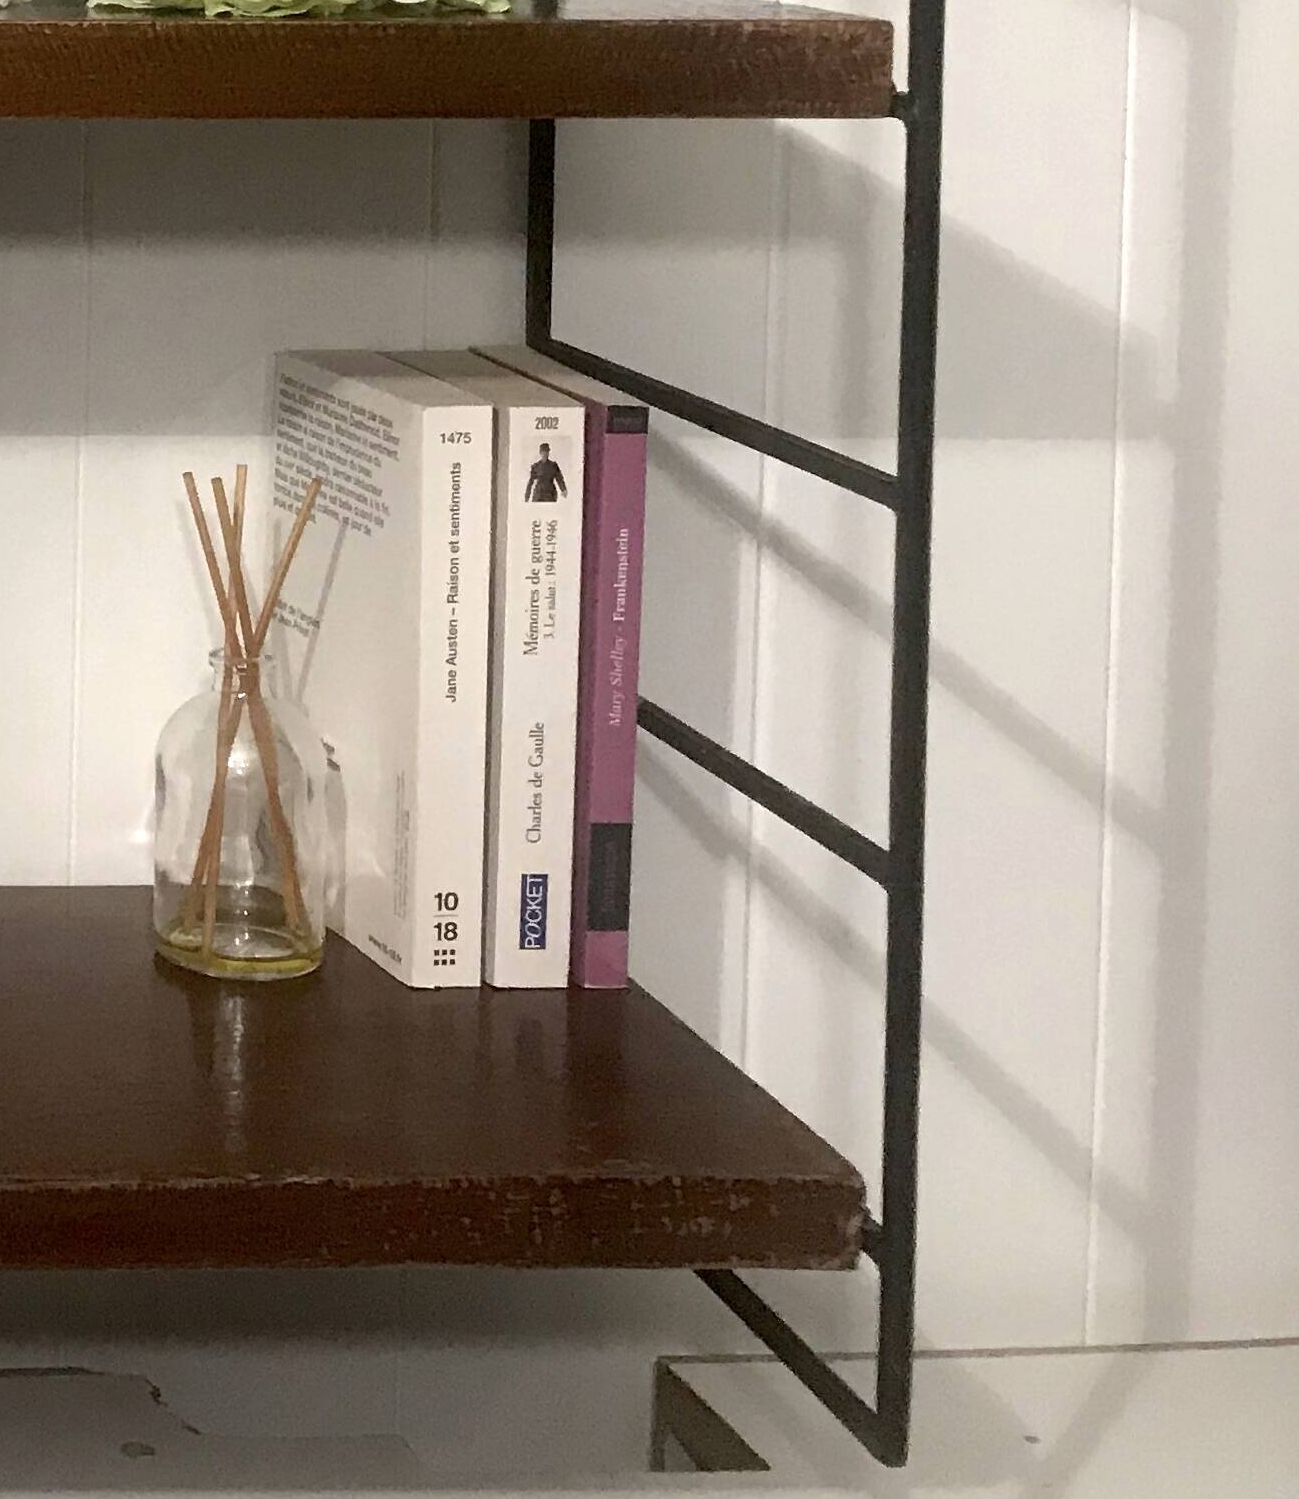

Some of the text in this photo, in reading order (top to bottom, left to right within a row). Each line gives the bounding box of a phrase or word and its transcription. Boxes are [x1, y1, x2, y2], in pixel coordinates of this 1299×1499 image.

[440, 432, 472, 444] 1475
[535, 416, 559, 430] 2002
[448, 462, 462, 537] sentiments
[450, 540, 461, 553] et
[446, 558, 461, 604] Raison
[523, 520, 543, 655] Mémoires de guerre
[613, 528, 629, 621] Frankenstein
[446, 620, 459, 666] Austen
[609, 635, 628, 686] Shelley
[445, 670, 457, 702] Jane
[609, 692, 625, 726] Mary
[525, 722, 545, 844] Charles de Gaulle
[434, 892, 459, 912] 10
[525, 874, 544, 949] POCKET
[434, 922, 459, 942] 18
